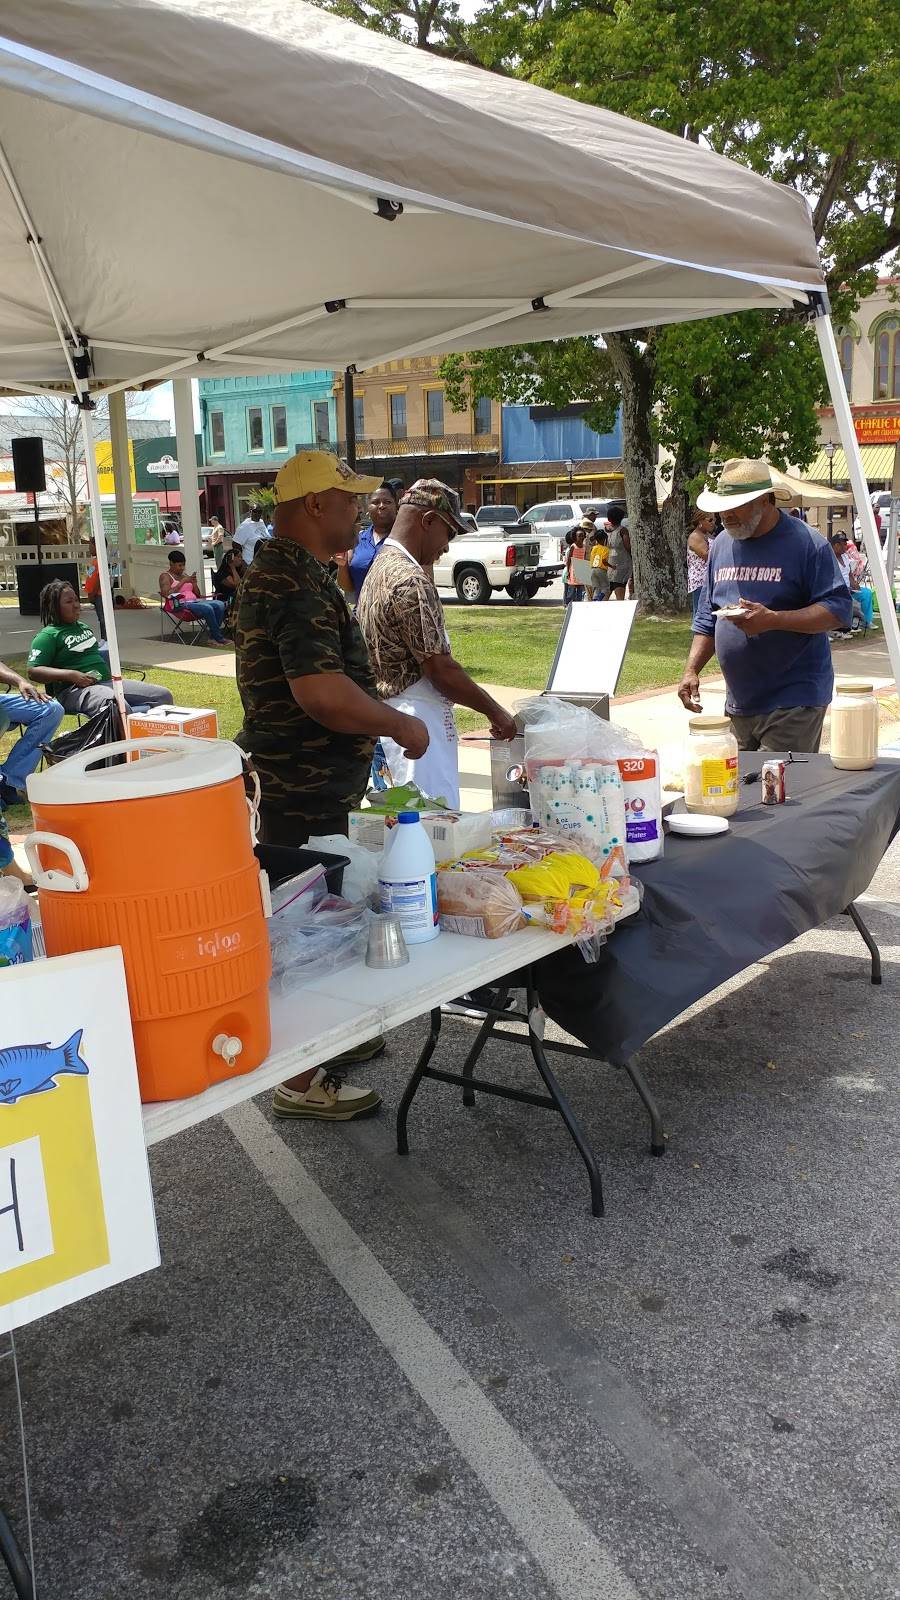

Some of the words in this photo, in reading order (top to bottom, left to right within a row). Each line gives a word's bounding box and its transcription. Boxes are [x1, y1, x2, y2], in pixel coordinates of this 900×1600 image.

[854, 418, 890, 430] CHARLIE
[757, 566, 782, 582] HOPE
[623, 760, 645, 772] 320
[562, 822, 582, 830] CUPS
[627, 831, 647, 839] Plates
[197, 931, 241, 958] igloo
